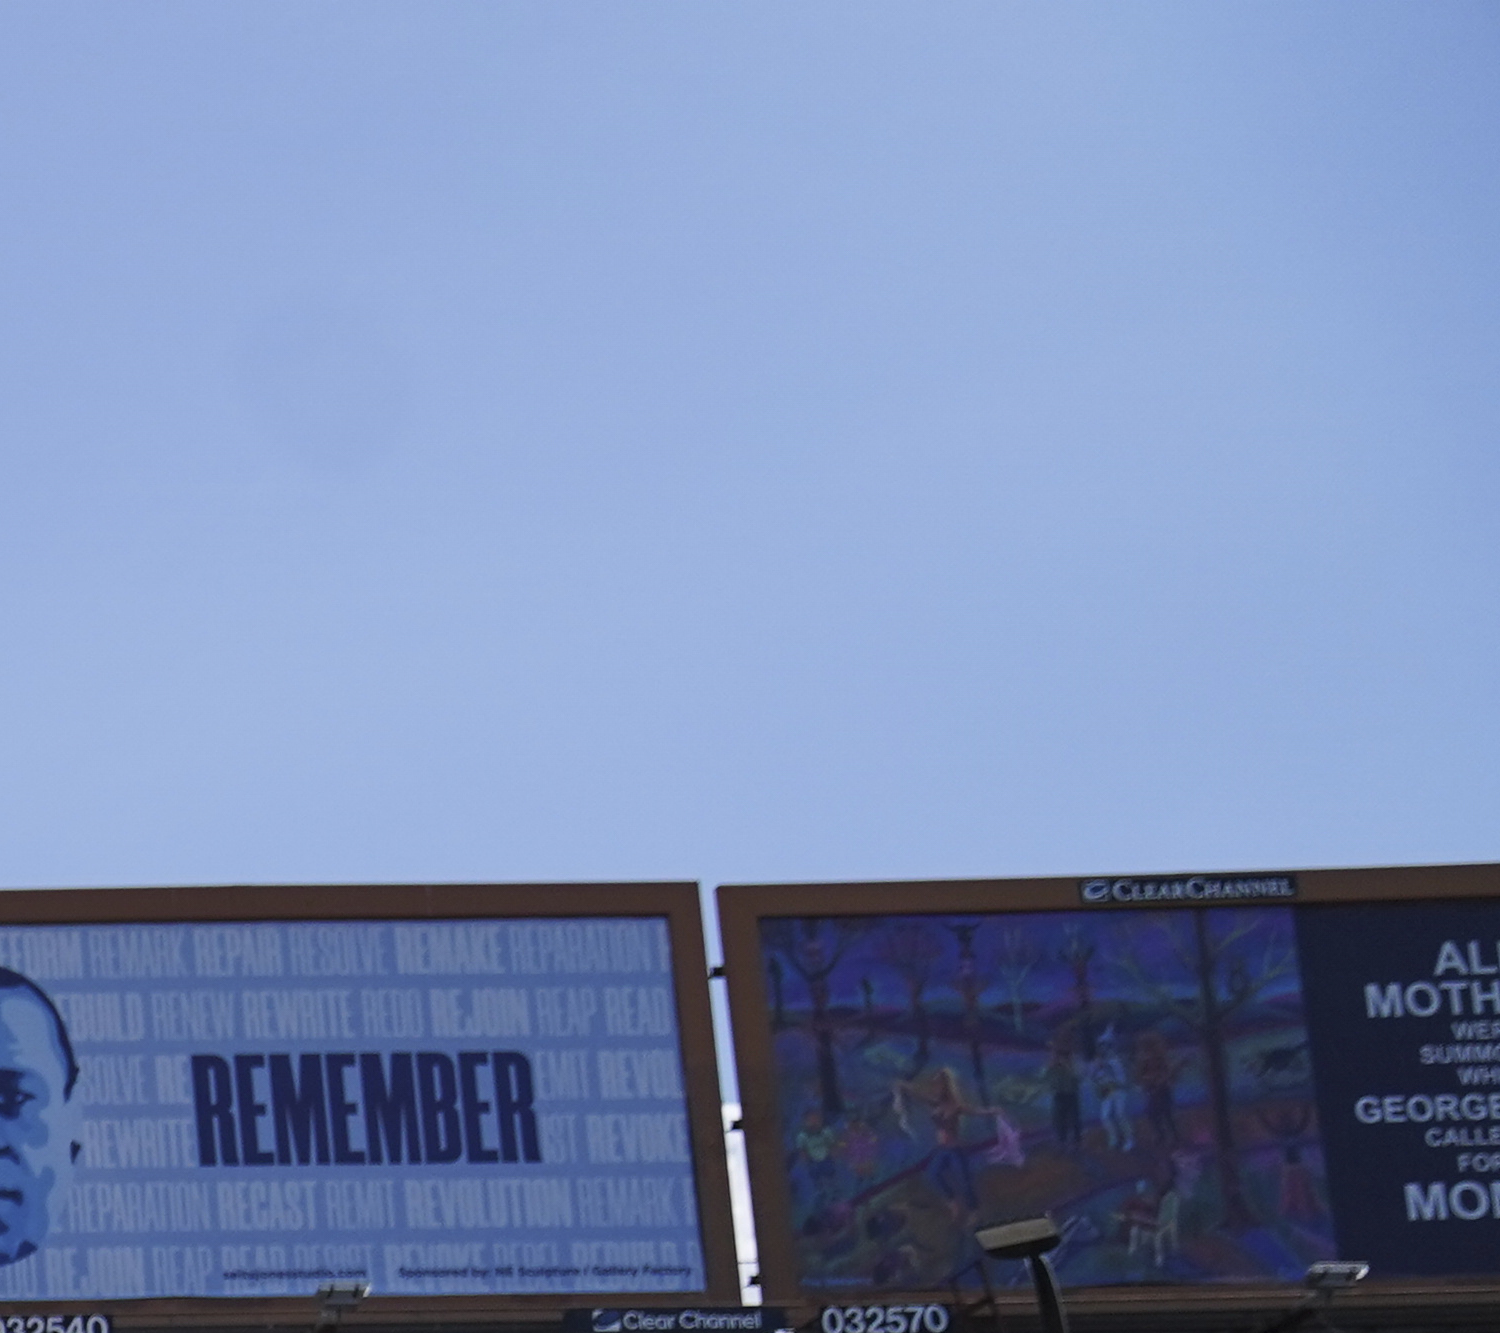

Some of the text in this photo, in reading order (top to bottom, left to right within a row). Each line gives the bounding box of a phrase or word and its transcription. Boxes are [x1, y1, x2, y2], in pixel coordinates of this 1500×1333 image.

[199, 926, 284, 977] REPAIR
[396, 924, 504, 975] REMAKE
[191, 1050, 543, 1168] REMEMBER
[1354, 1093, 1500, 1125] GEORGE
[622, 1309, 763, 1331] Clear Channel
